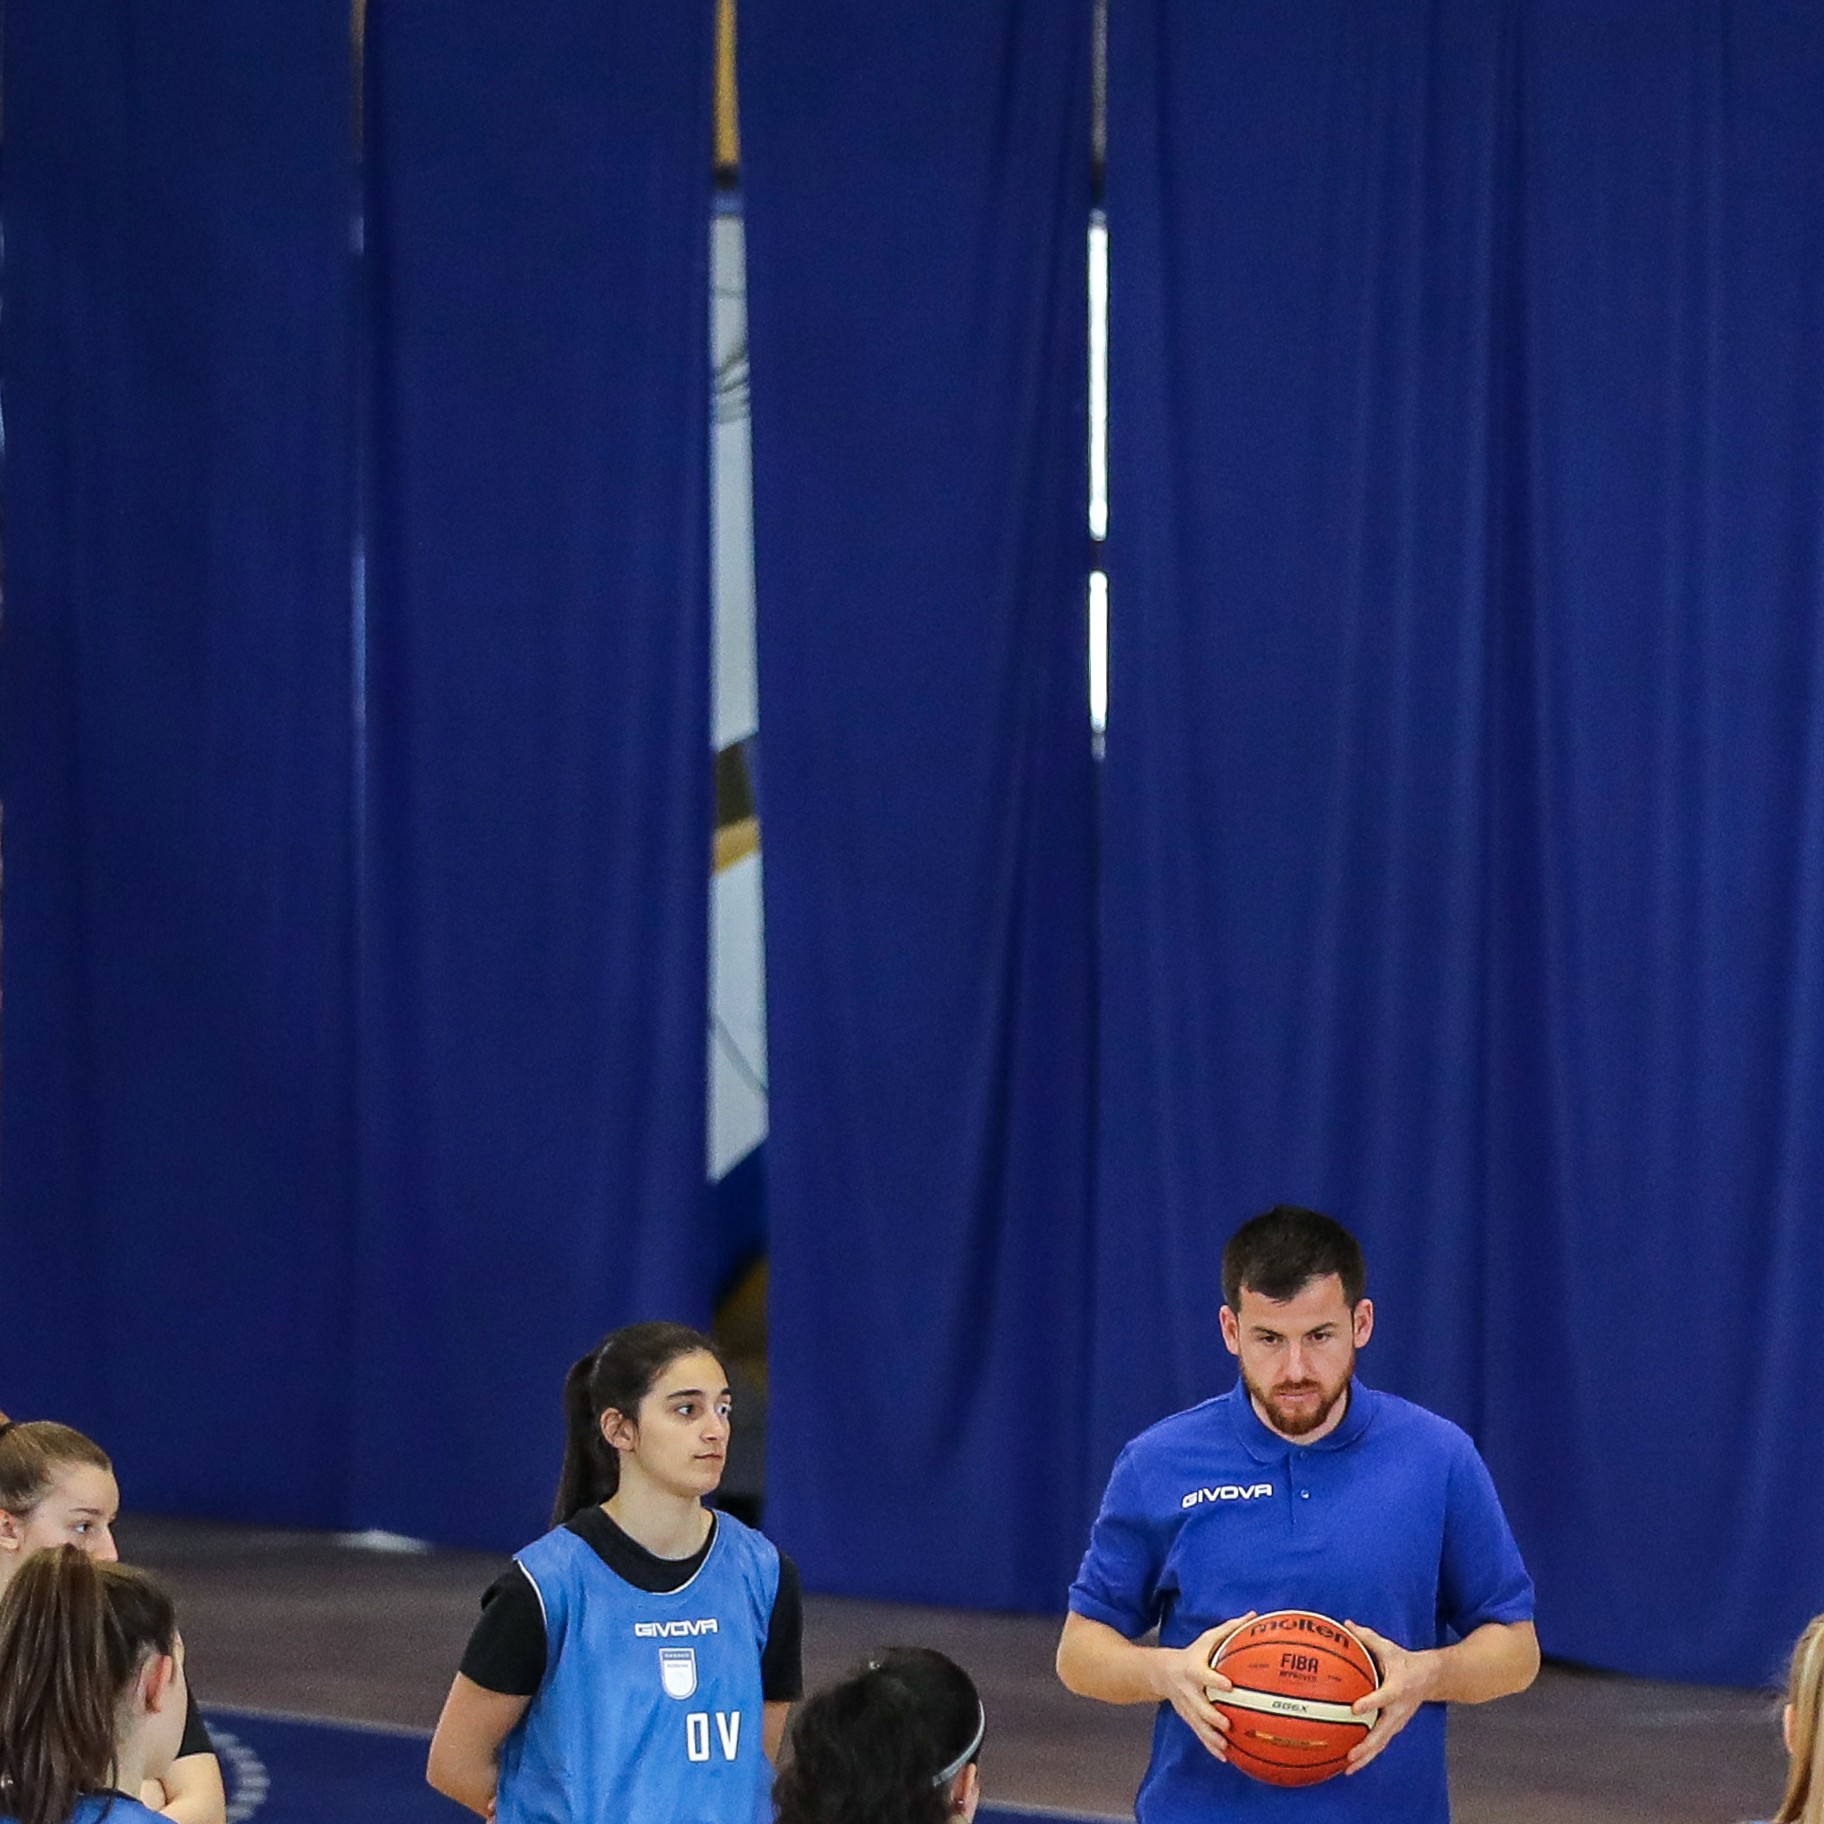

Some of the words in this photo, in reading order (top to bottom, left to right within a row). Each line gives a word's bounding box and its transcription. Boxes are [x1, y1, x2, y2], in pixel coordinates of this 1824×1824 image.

[1181, 1483, 1273, 1508] GIVOVA
[634, 1618, 719, 1638] GIVOVA
[1250, 1618, 1350, 1650] molten
[1280, 1653, 1319, 1674] FIBA
